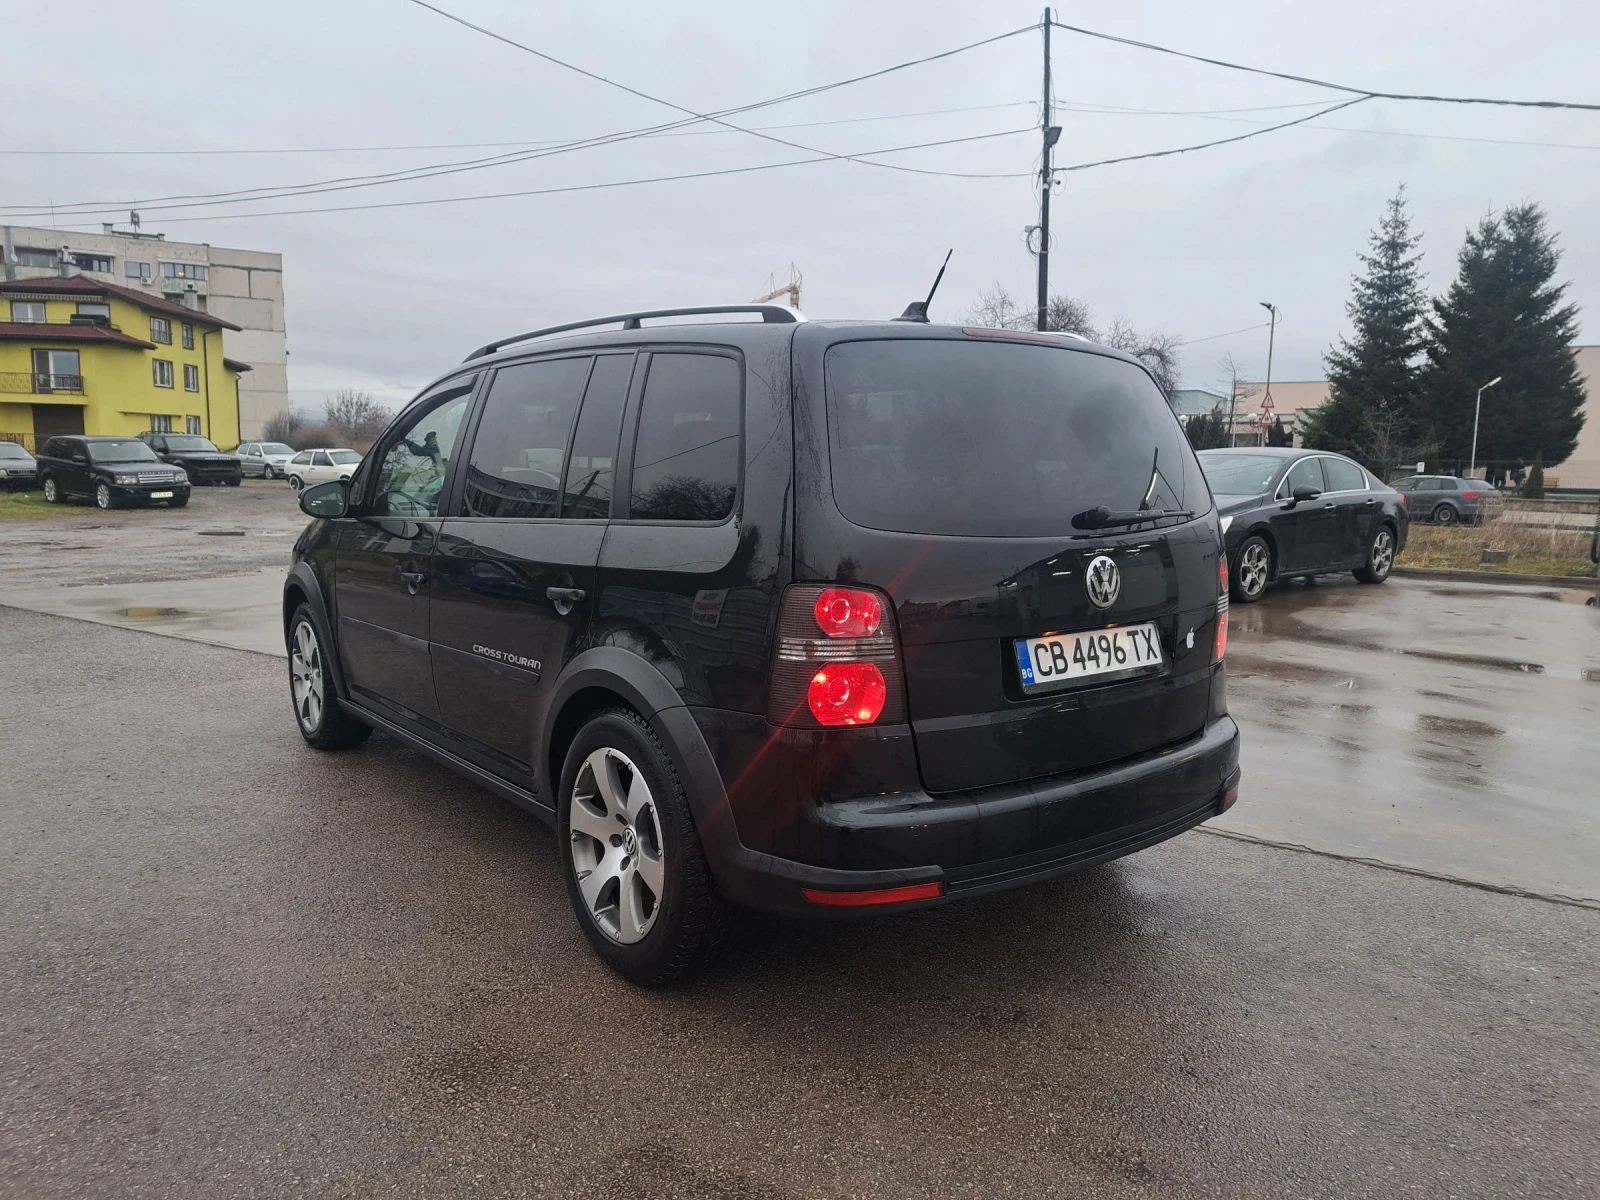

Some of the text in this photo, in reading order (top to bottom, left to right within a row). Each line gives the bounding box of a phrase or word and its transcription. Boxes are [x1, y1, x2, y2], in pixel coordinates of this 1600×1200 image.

[472, 644, 541, 670] CROSS TOURAN
[1033, 629, 1158, 677] CB 4496 TX
[1021, 668, 1033, 679] BG
